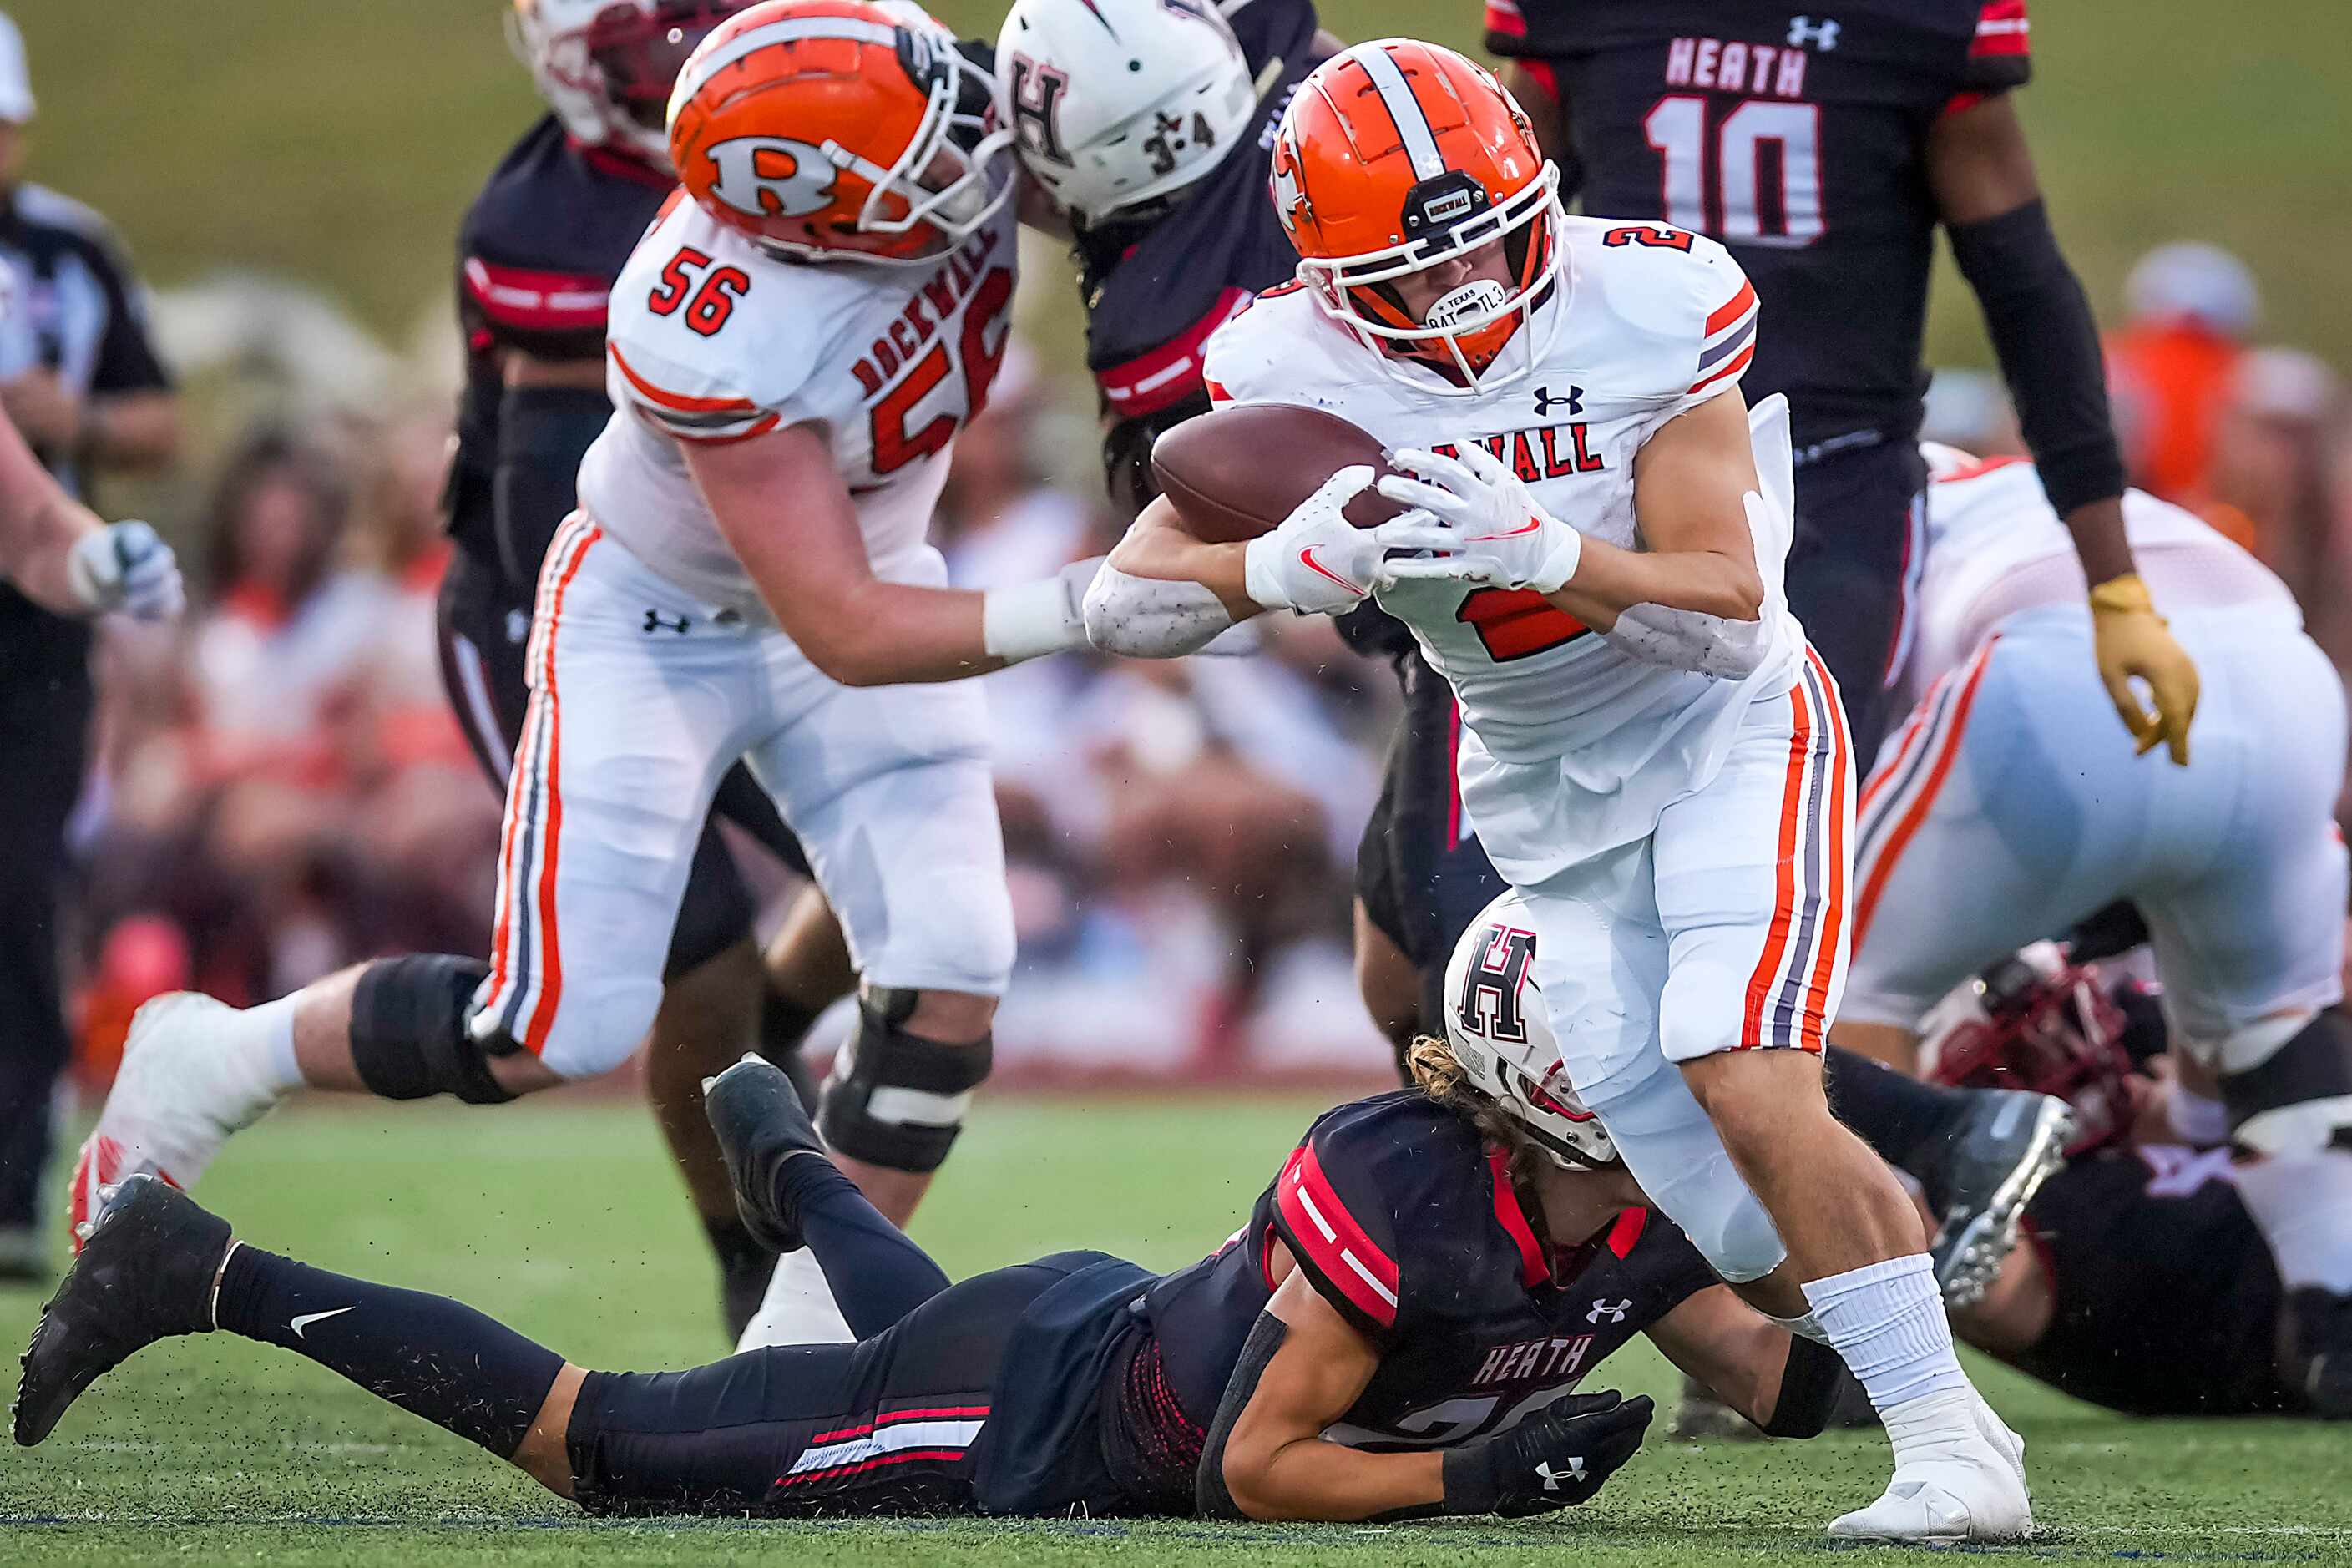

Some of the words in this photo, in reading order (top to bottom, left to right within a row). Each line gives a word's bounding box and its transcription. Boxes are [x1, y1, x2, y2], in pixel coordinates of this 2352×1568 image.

[1665, 37, 1808, 99] HEATH
[1010, 52, 1075, 168] H
[705, 136, 837, 217] R
[1643, 93, 1828, 249] 10
[1603, 226, 1694, 254] 2
[648, 246, 751, 337] 56
[1448, 289, 1475, 307] TEXAS
[1458, 923, 1536, 1044] H
[1470, 1336, 1593, 1385] HEATH
